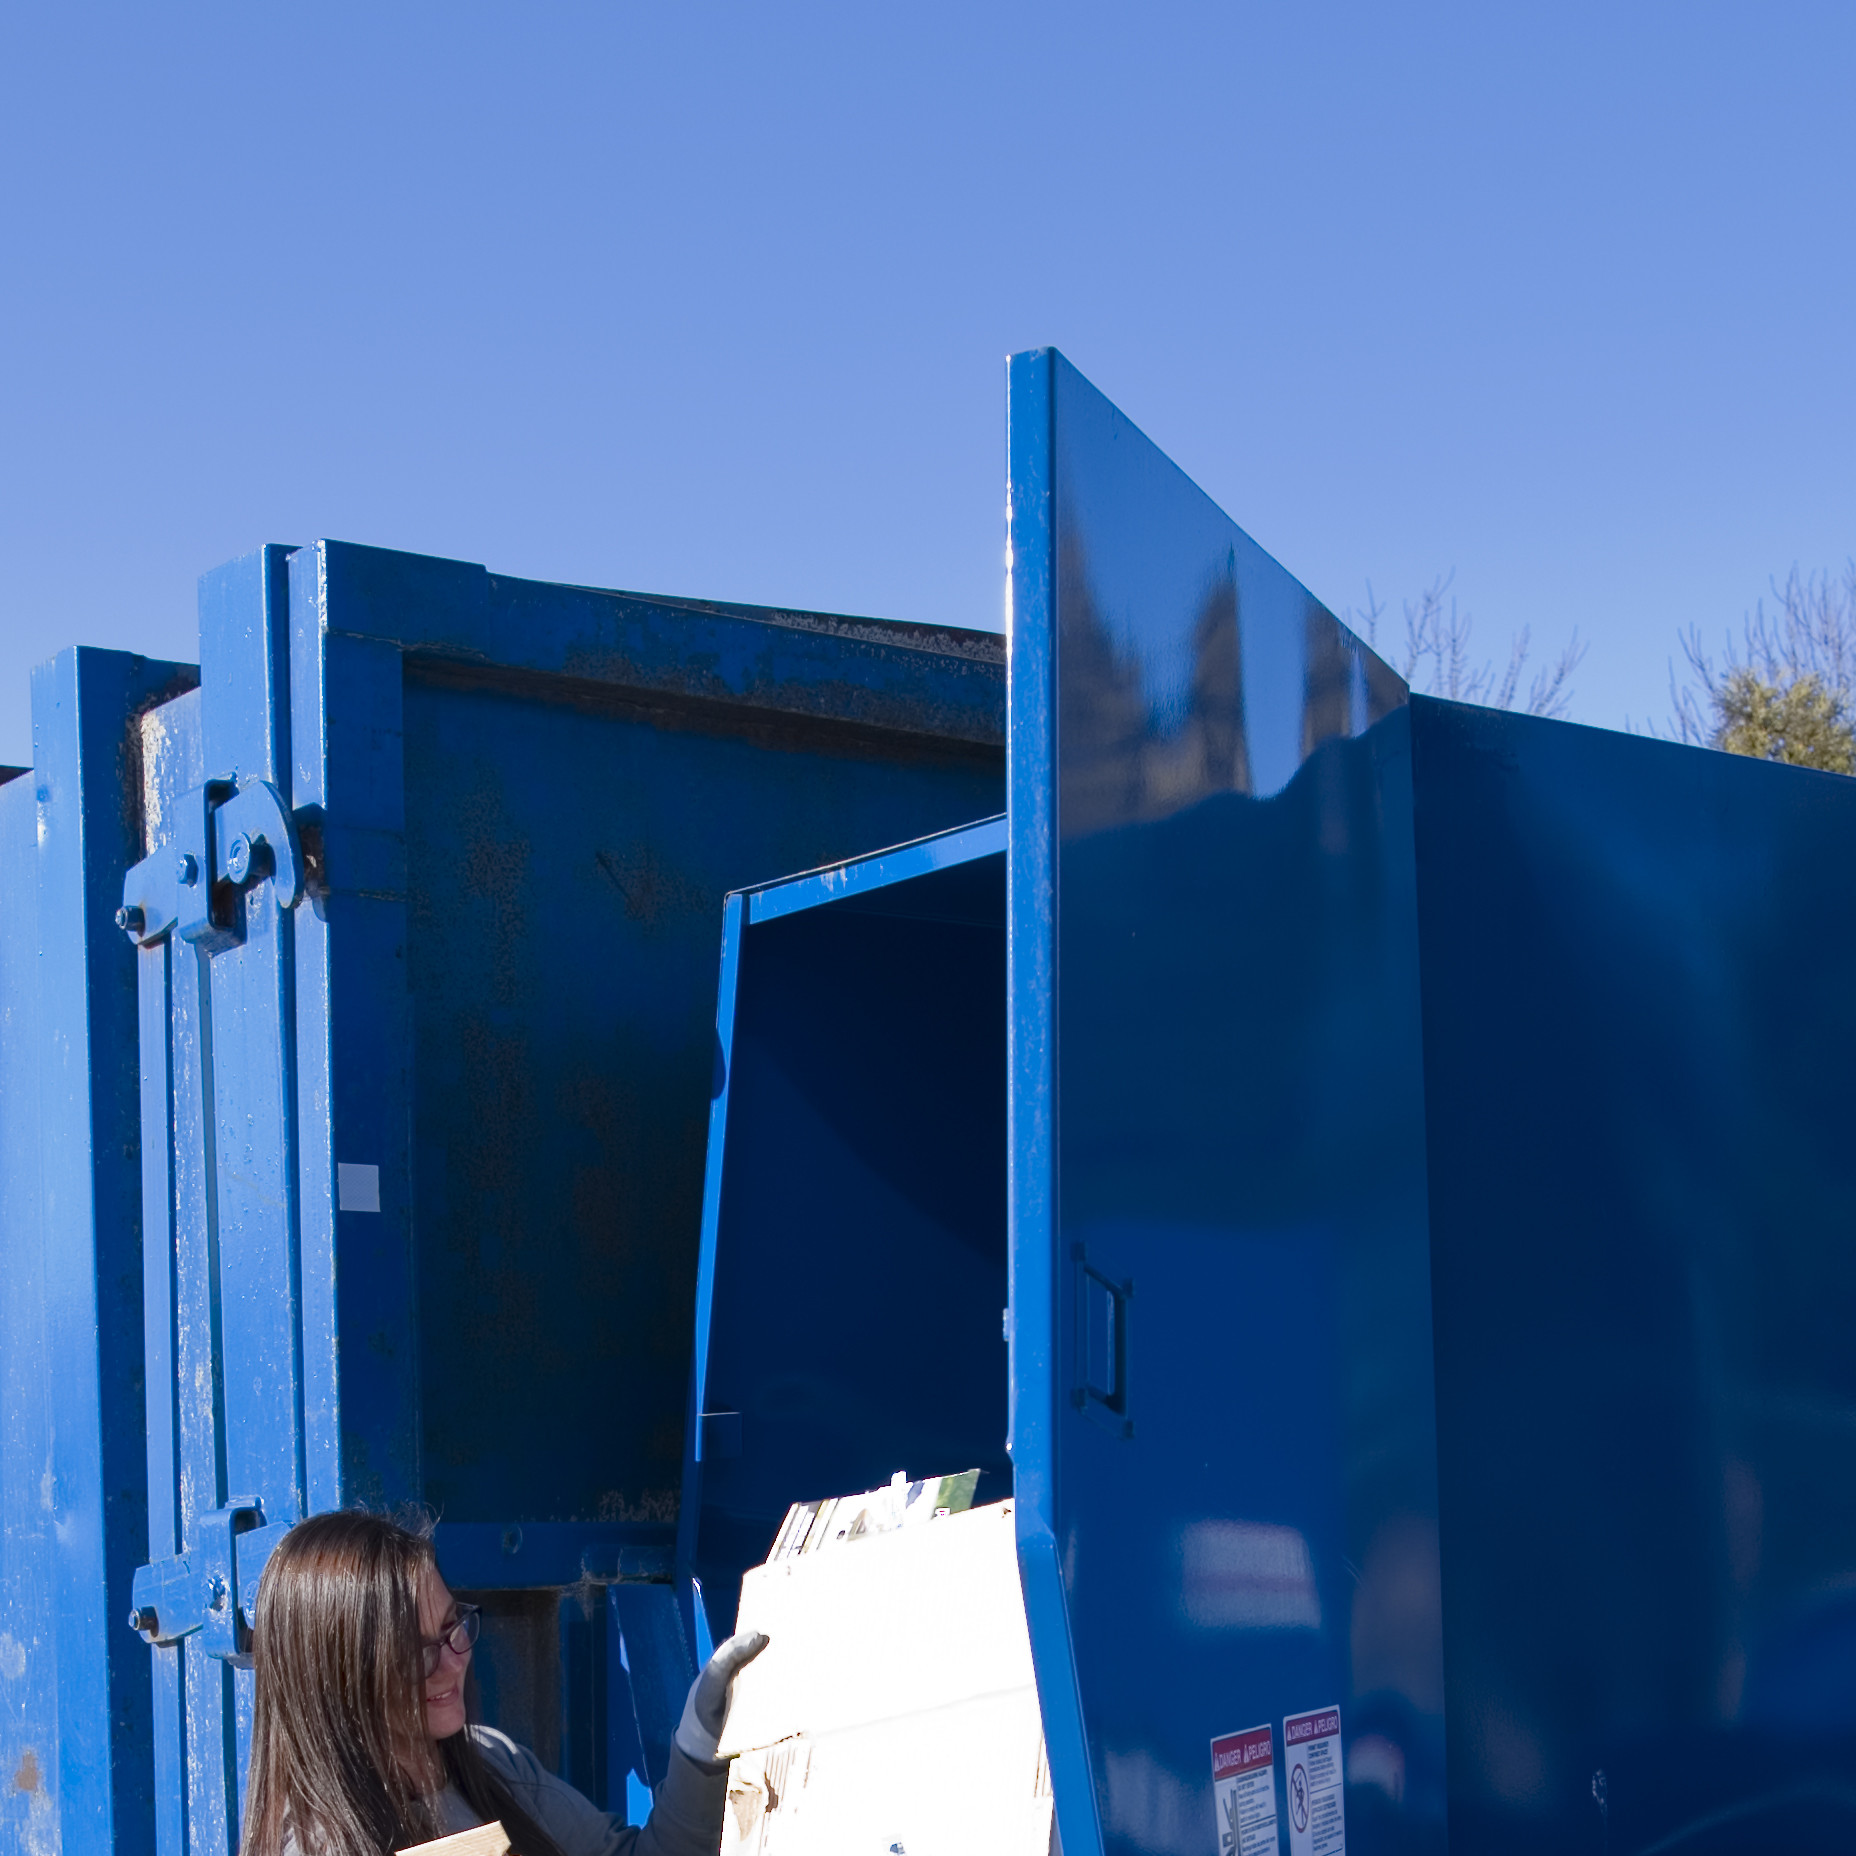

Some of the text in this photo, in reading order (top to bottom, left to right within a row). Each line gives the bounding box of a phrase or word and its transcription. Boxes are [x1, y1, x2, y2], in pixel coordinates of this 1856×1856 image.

[1292, 1715, 1338, 1738] DANGER PELIGRO
[1219, 1740, 1271, 1769] DANGER PELIGRO
